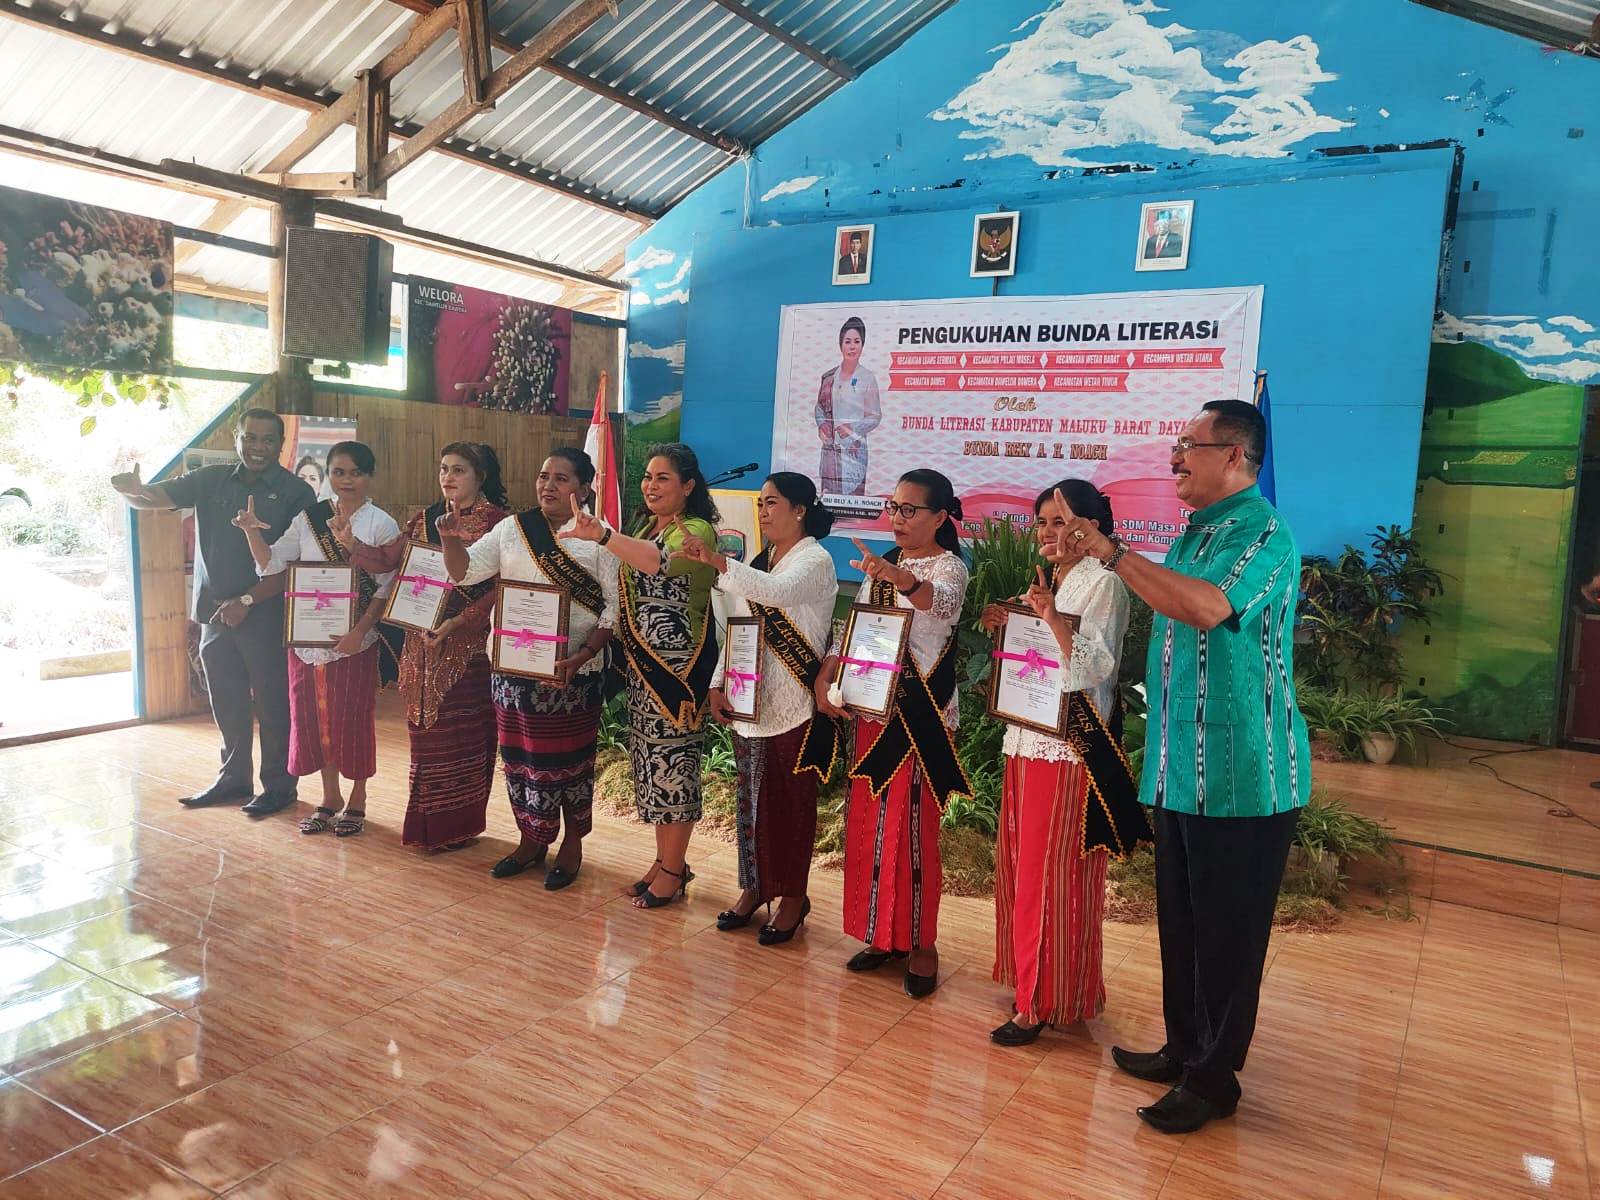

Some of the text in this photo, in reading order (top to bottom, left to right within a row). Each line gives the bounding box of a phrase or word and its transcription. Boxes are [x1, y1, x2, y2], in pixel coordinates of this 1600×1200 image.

[418, 284, 464, 304] WELORA
[898, 320, 1219, 345] PENGUKUHAN BUNDA LITERASI
[1056, 354, 1085, 364] KECAMATAN
[1143, 353, 1175, 363] KECAMATAN
[1054, 376, 1083, 386] KECAMATAN
[993, 396, 1037, 411] Oleh
[902, 416, 935, 430] BUNDA
[940, 416, 986, 431] LITERASI
[991, 417, 1054, 432] KABUPATEN
[1059, 418, 1107, 434] MALUKU
[1114, 420, 1152, 435] BARAT
[963, 440, 1107, 460] BUNDA RELY A. H. NOACH
[1122, 519, 1145, 530] SDM
[1148, 521, 1175, 532] Masa
[1126, 532, 1144, 542] dan
[1148, 533, 1176, 546] Komp
[772, 620, 813, 664] Literasi
